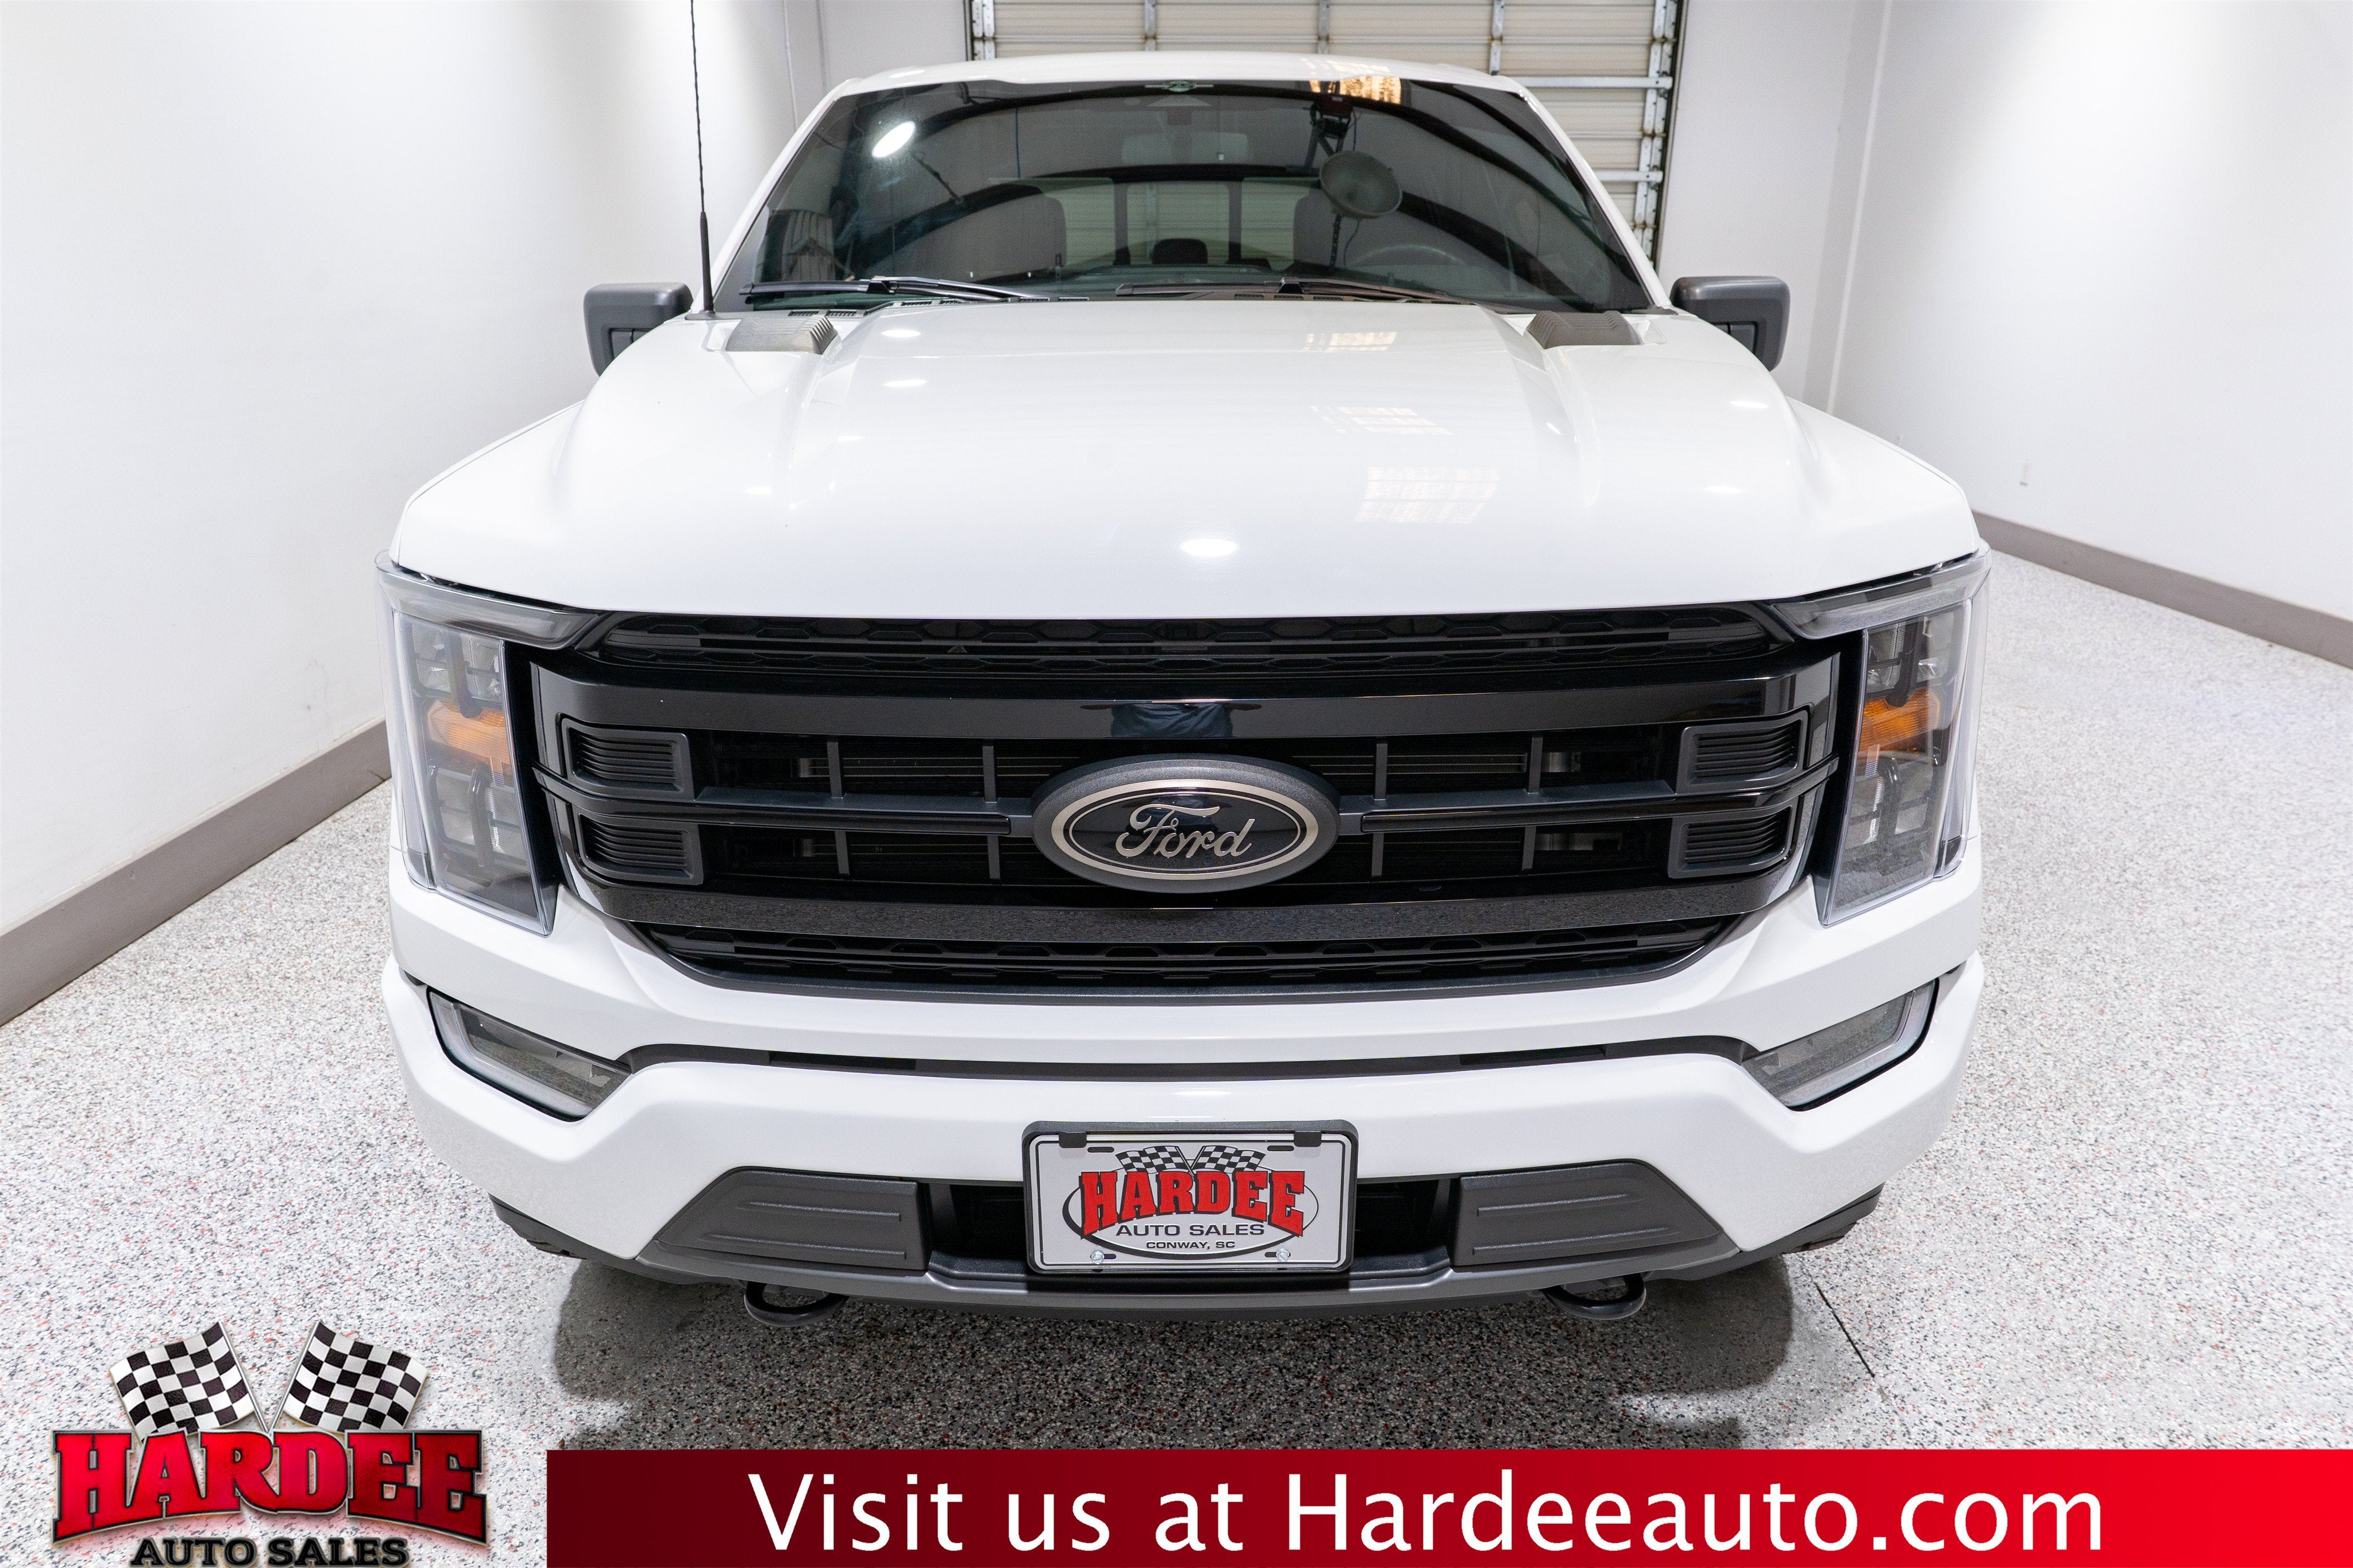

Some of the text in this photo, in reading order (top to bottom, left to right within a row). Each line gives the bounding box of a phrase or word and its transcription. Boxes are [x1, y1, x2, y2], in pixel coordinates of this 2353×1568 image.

[1116, 804, 1256, 858] Ford
[1079, 1171, 1306, 1239] HARDEE
[1116, 1224, 1265, 1236] AUTO SALES
[1146, 1241, 1236, 1250] CONWAY, SC
